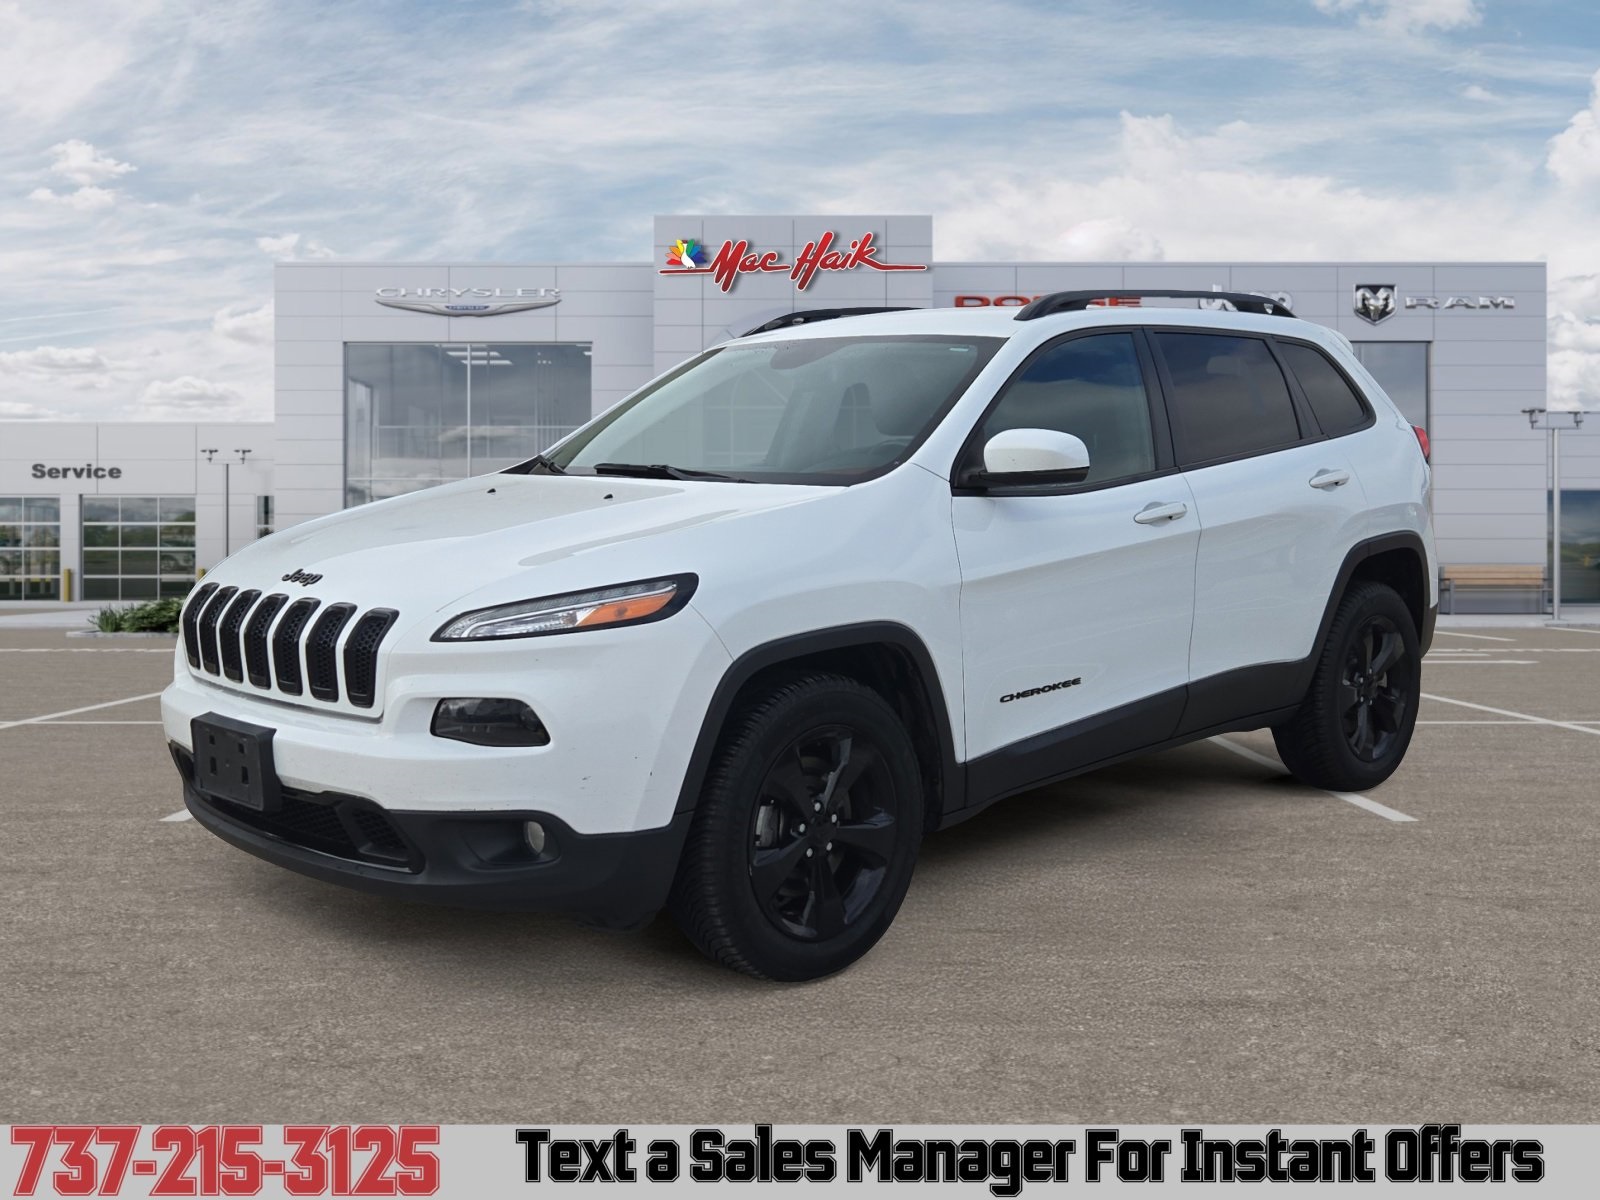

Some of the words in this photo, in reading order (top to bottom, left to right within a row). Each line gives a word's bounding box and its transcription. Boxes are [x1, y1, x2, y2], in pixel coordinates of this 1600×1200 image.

[708, 239, 791, 293] Mac
[790, 231, 927, 291] Haik
[376, 287, 561, 298] CHRYSLER
[1404, 296, 1516, 309] RAM
[31, 463, 122, 479] Service
[281, 568, 324, 587] Jeep
[999, 677, 1082, 703] CHEROKEE
